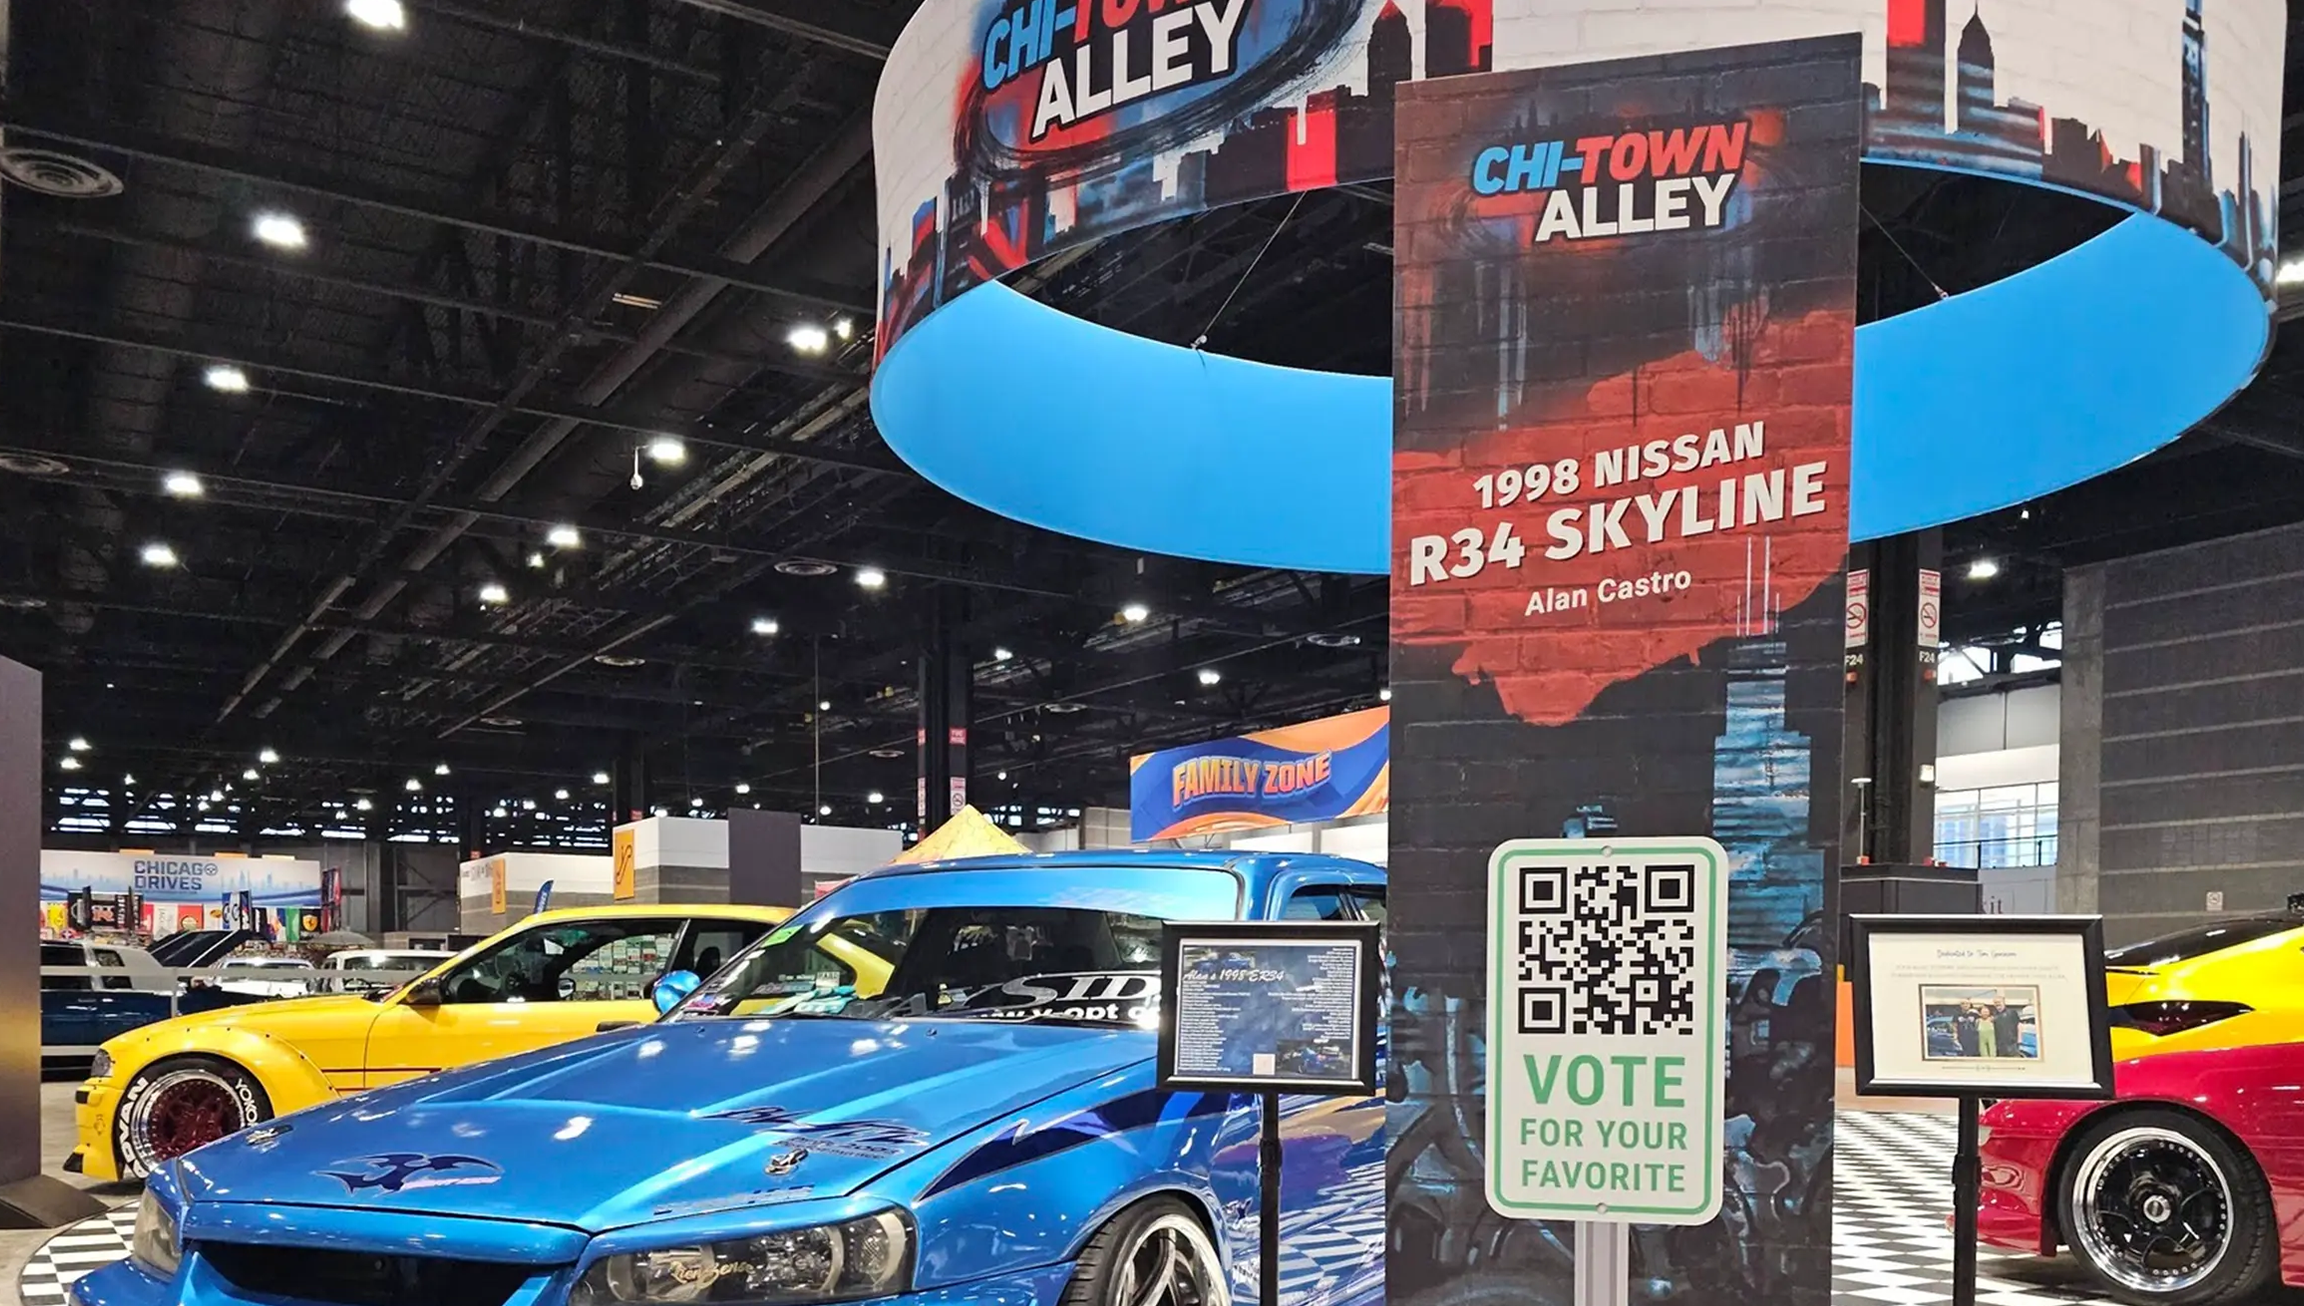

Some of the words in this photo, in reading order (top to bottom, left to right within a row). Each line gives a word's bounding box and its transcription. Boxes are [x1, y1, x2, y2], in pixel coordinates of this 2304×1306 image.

[1032, 0, 1245, 138] ALLEY
[1473, 121, 1748, 195] CHI-TOWN
[1535, 173, 1736, 242] ALLEY
[1472, 458, 1580, 510] 1998
[1594, 420, 1765, 488] NISSAN
[1409, 522, 1526, 587] R34
[1545, 460, 1828, 562] SKYLINE
[1524, 583, 1588, 617] Alan
[1597, 569, 1692, 604] Castro
[1919, 651, 1935, 663] F24
[1172, 757, 1261, 809] FAMILY
[1262, 750, 1332, 797] ZONE
[134, 875, 202, 891] DRIVES
[1219, 968, 1247, 981] 1998
[1522, 1053, 1686, 1107] VOTE
[119, 1077, 151, 1179] ADVAN
[1520, 1118, 1584, 1147] FOR
[1596, 1120, 1688, 1150] YOUR
[1521, 1159, 1686, 1193] FAVORITE
